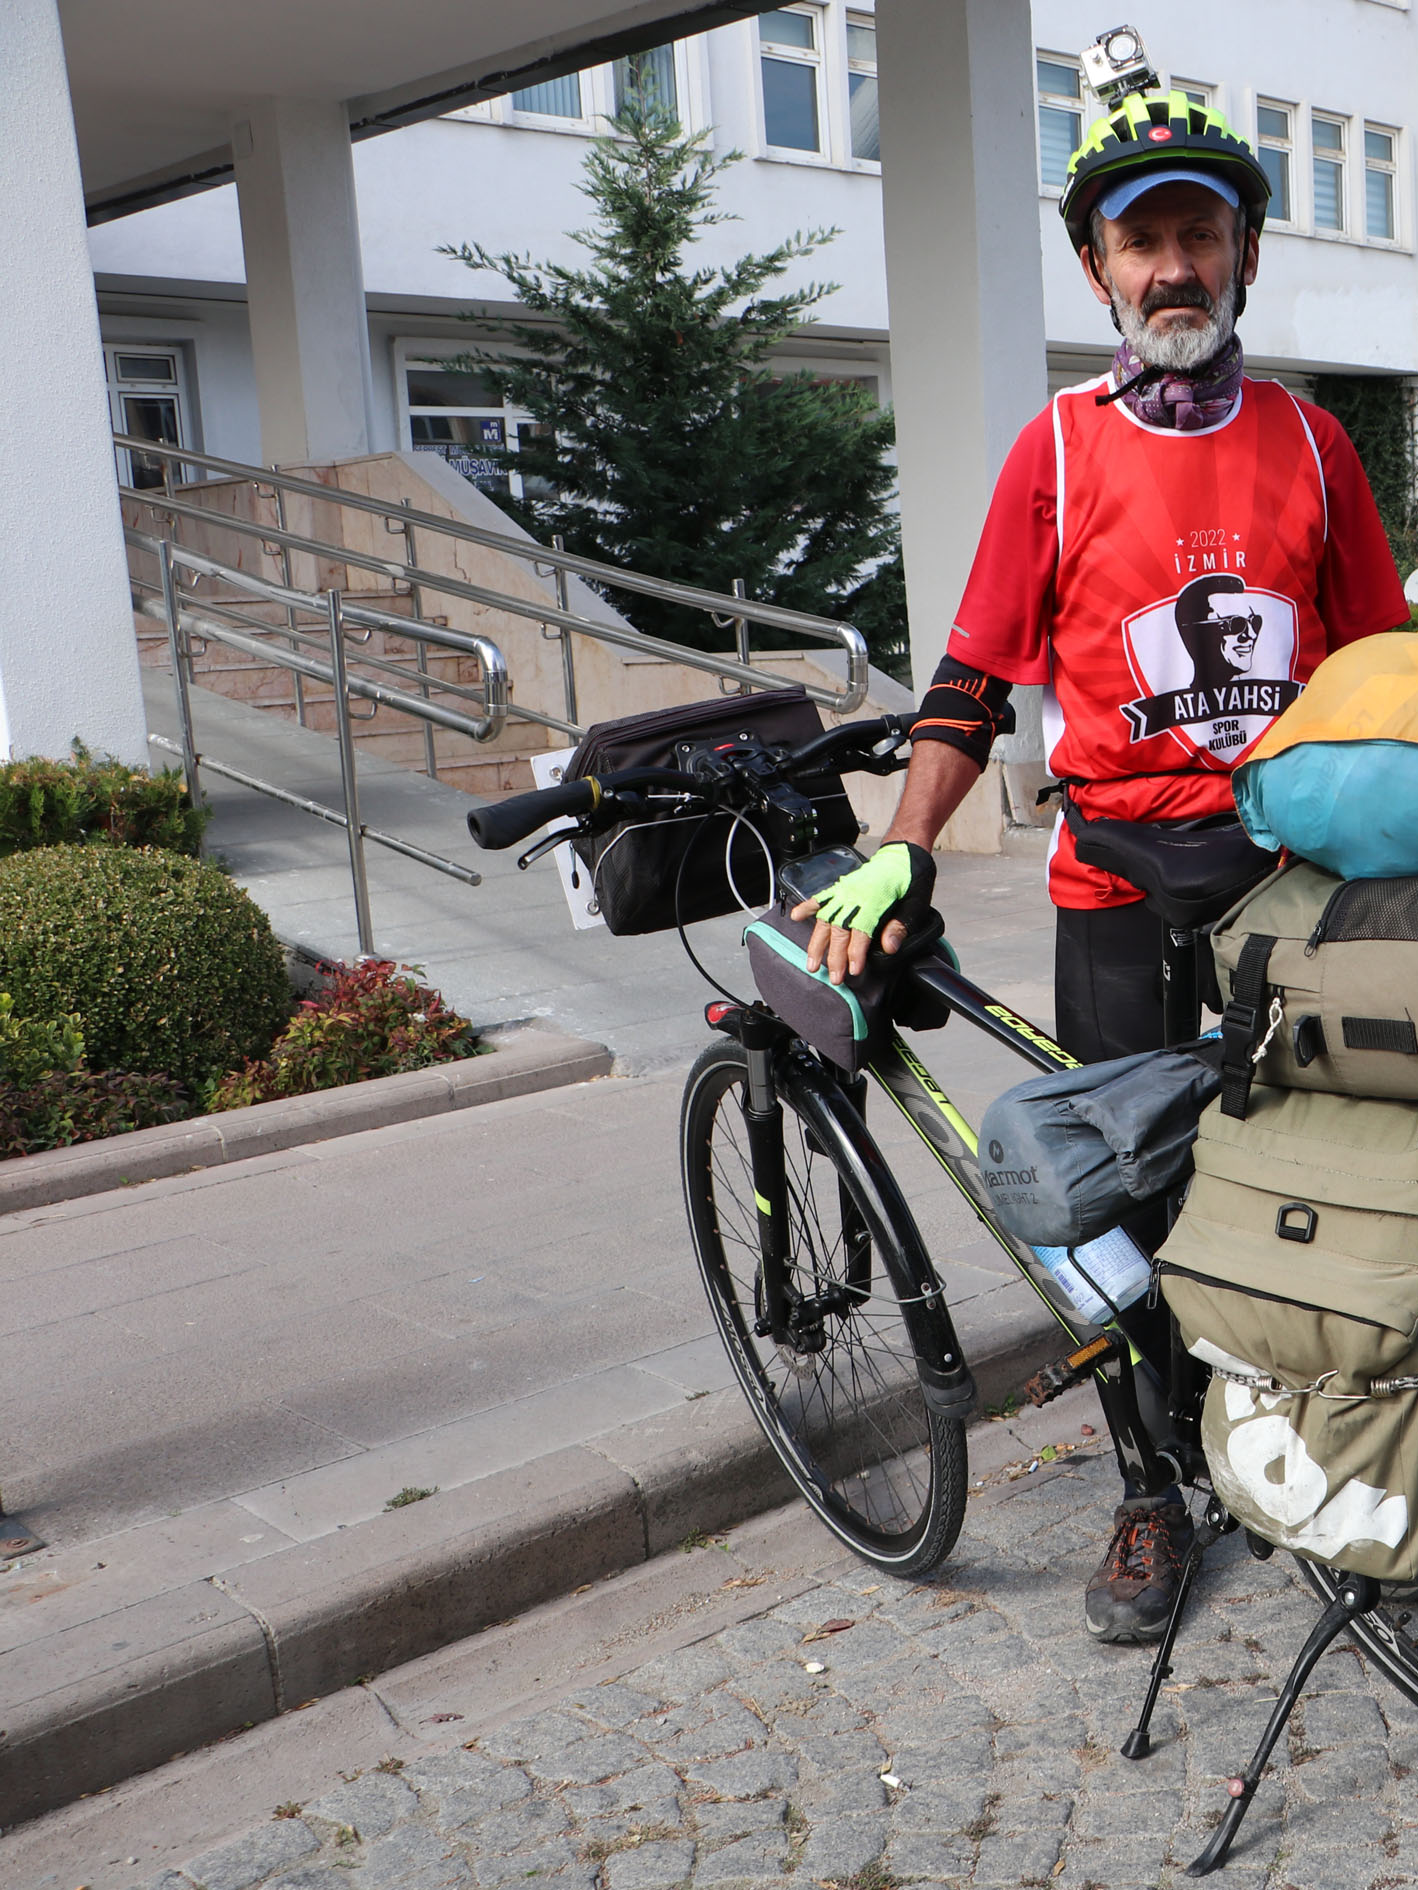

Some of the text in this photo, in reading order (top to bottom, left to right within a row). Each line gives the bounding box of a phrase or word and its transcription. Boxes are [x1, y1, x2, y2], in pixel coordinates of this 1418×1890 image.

[1190, 528, 1227, 548] 2022
[1174, 548, 1246, 574] İZMİR
[1174, 691, 1211, 720] ATA
[1212, 719, 1239, 735] SPOR
[1208, 730, 1247, 751] KULÜBÜ
